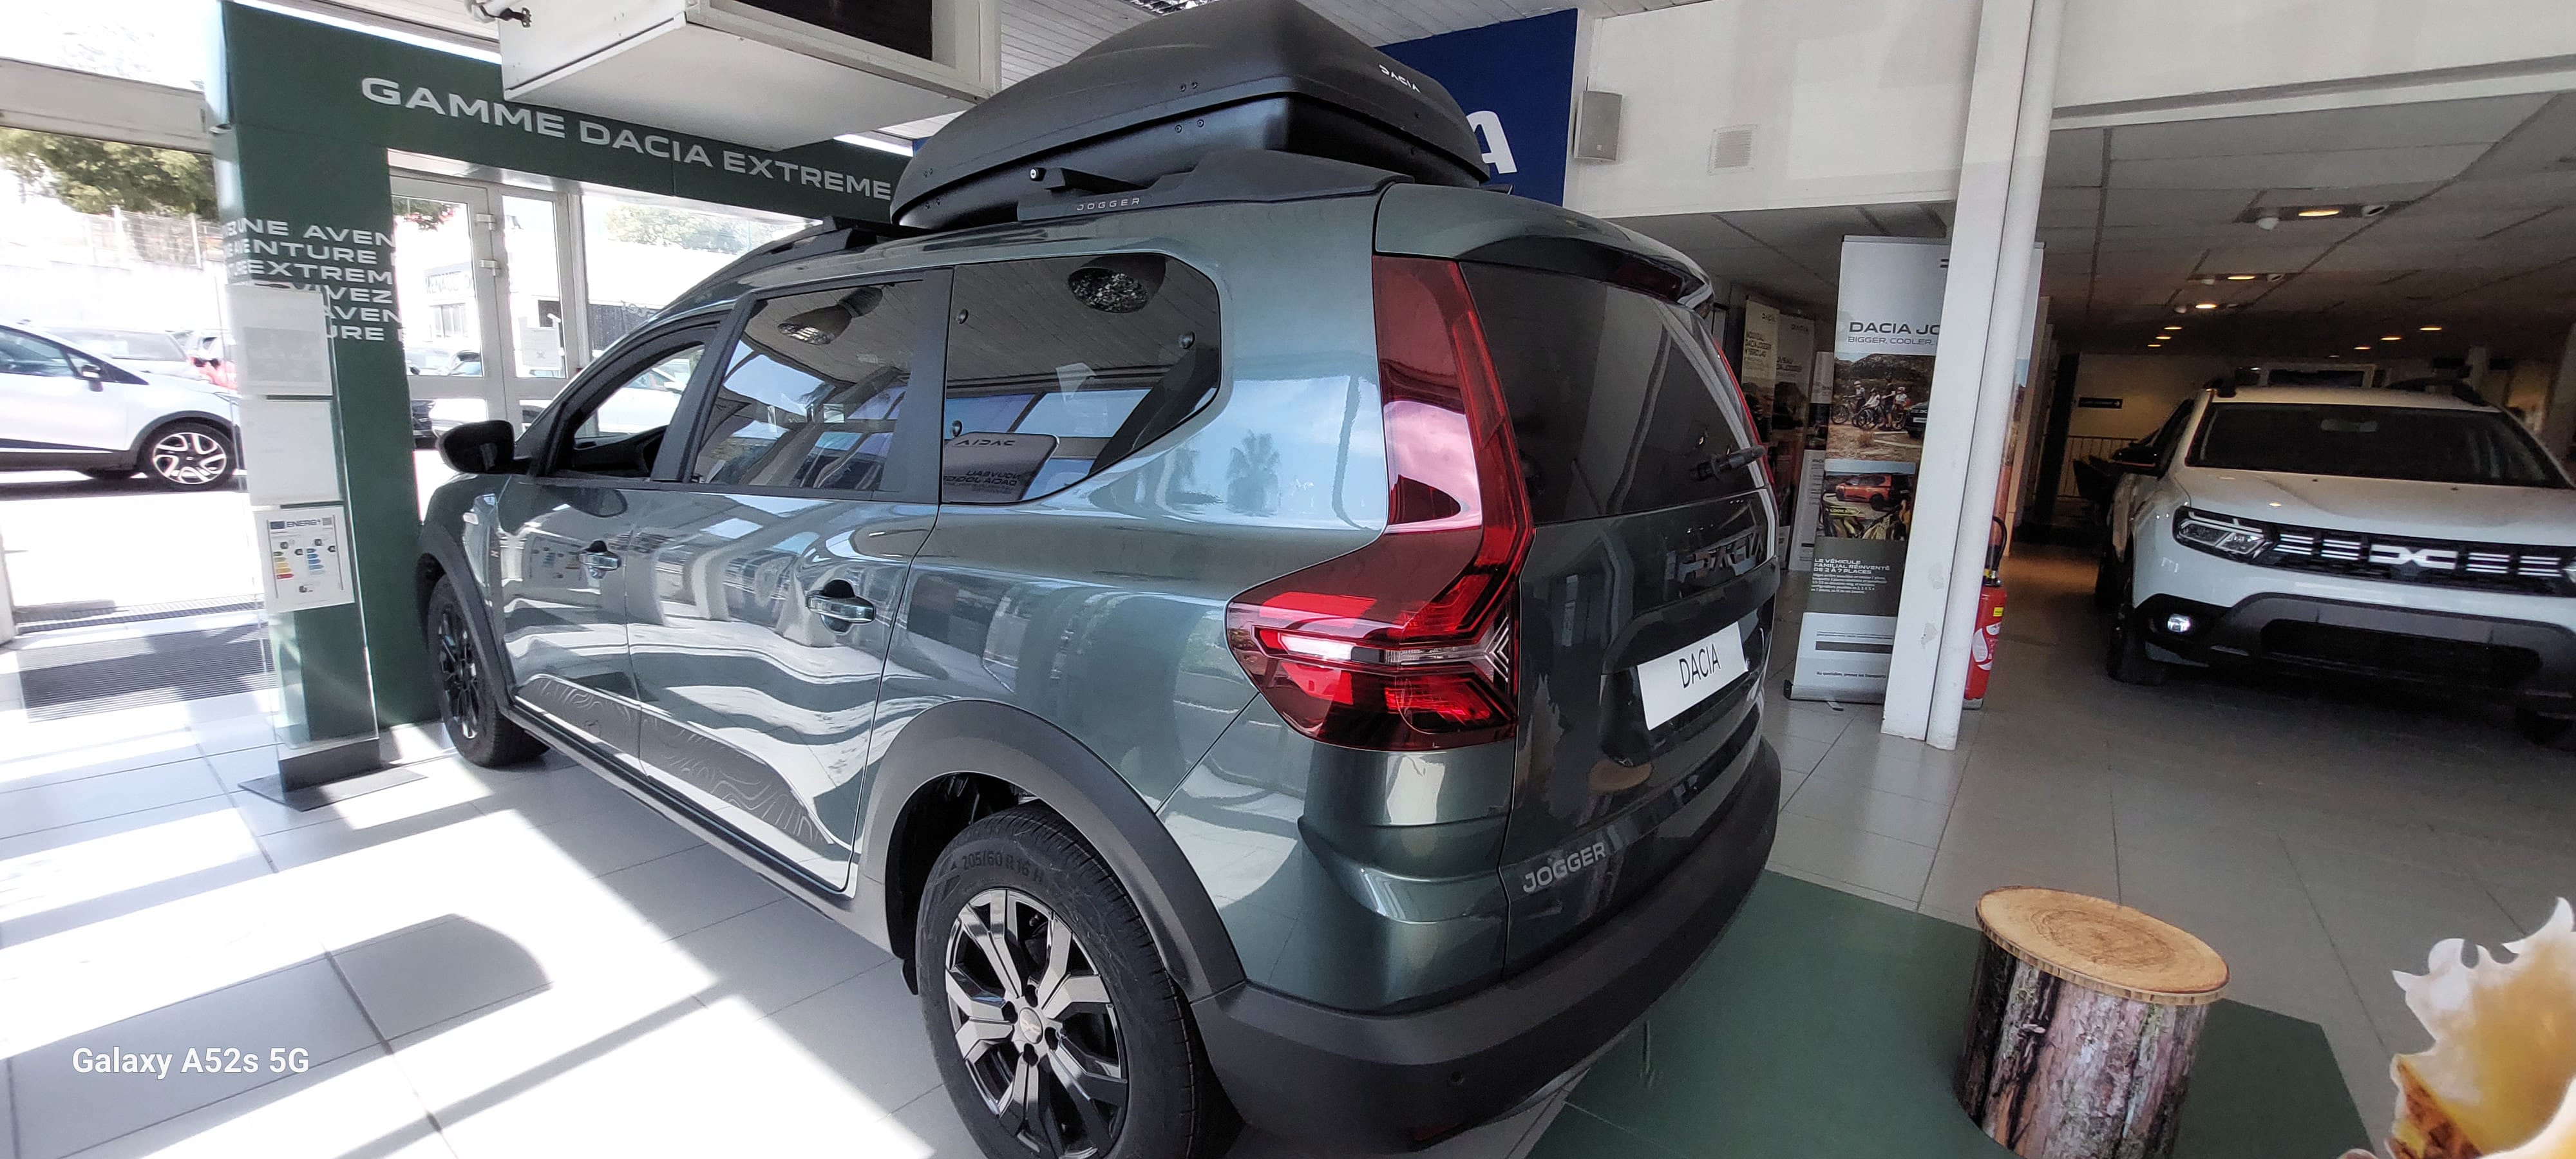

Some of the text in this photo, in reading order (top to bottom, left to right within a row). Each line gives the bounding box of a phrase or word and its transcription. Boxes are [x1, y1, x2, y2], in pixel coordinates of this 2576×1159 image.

[1379, 64, 1421, 93] DACIA
[361, 77, 891, 201] GAMME DACIA EXTREME
[1076, 198, 1140, 211] JOGGER
[1849, 321, 1912, 334] DACIA
[1678, 643, 1721, 689] DACIA
[1522, 842, 1606, 893] JOGGER
